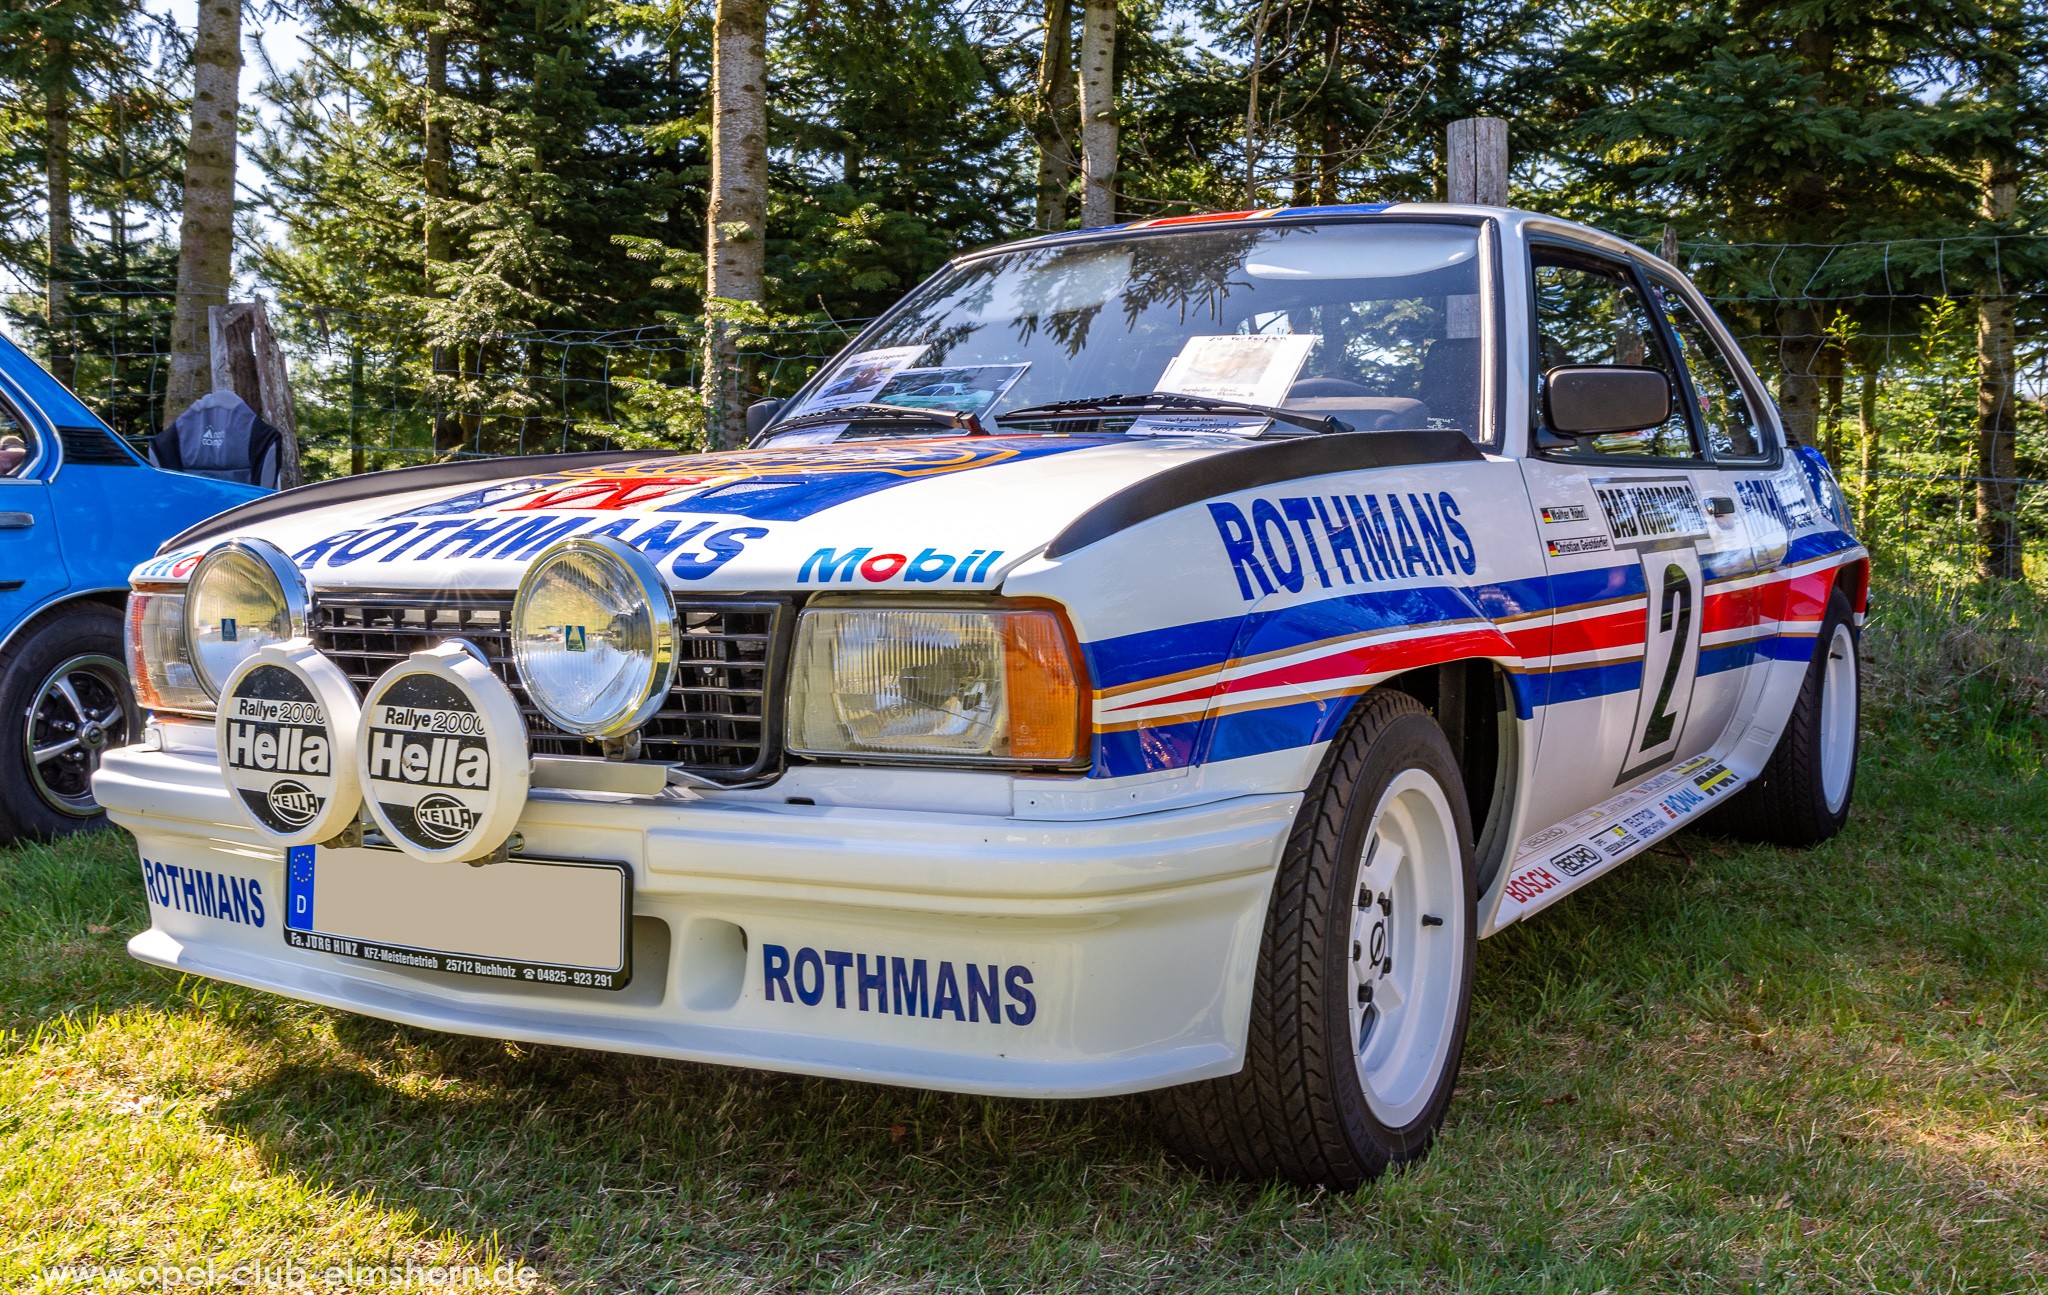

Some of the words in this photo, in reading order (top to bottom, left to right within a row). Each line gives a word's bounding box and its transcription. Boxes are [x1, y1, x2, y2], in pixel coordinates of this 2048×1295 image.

[1549, 508, 1571, 520] Walter
[1206, 491, 1477, 601] ROTHMANS
[1555, 541, 1581, 553] Christian
[797, 546, 1004, 584] Mobil
[1639, 563, 1692, 753] 2
[239, 698, 278, 718] Rallye
[384, 706, 431, 730] Rallye
[229, 722, 329, 774] Hella
[370, 731, 490, 787] Hella
[272, 793, 317, 813] HELLA
[1664, 787, 1704, 815] RONAL
[420, 808, 472, 832] HELLA
[1554, 847, 1598, 874] RECARO
[143, 857, 265, 929] ROTHMANS
[1505, 866, 1561, 903] BOSCH
[296, 894, 307, 914] D
[290, 931, 304, 947] Fa.
[333, 939, 358, 956] HINZ
[363, 946, 439, 969] KFZ-Meisterbetrieb
[445, 958, 473, 974] 25712
[474, 962, 517, 978] Buchholz
[594, 973, 612, 988] 291
[762, 943, 1037, 1027] ROTHMANS
